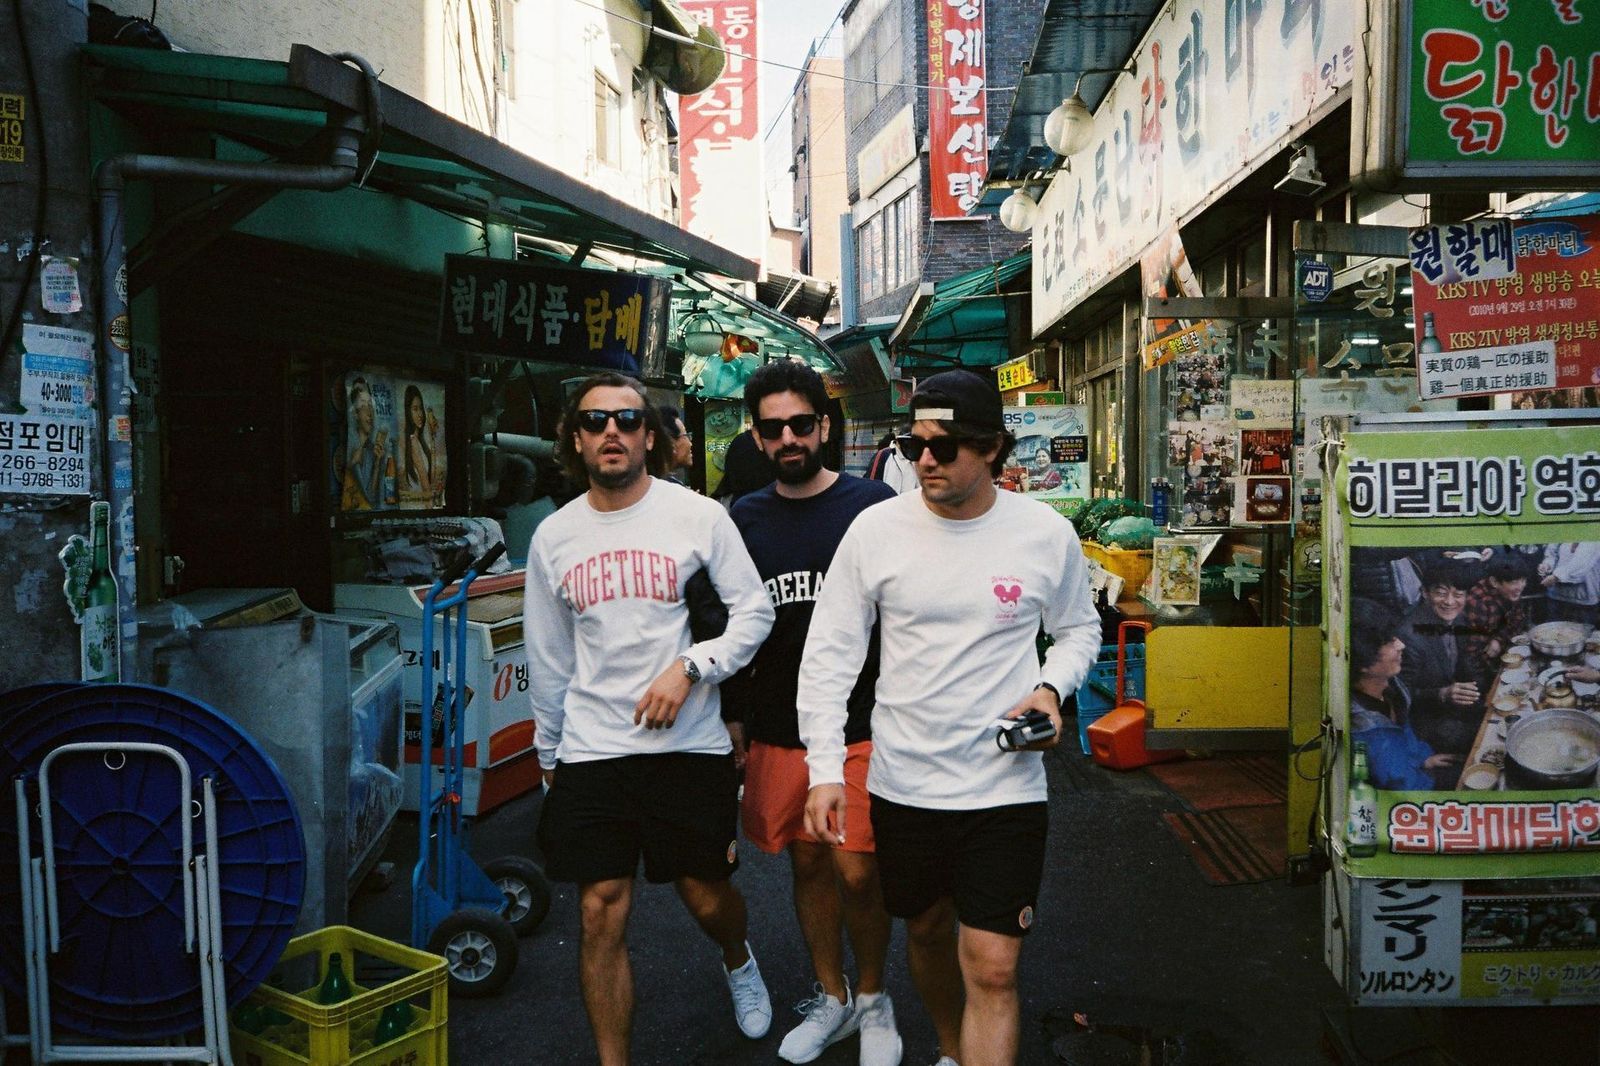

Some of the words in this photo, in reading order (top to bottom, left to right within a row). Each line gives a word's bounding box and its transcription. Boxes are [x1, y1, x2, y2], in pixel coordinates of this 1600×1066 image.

[1411, 218, 1515, 281] 원할매
[1303, 270, 1329, 288] ADT
[1529, 271, 1574, 294] 생방송
[1449, 331, 1476, 350] KBS
[1505, 326, 1531, 345] 방영
[1425, 349, 1549, 374] 実質の鶏一匹の援助
[1003, 412, 1023, 430] BS
[0, 421, 84, 454] 점포임대
[1348, 458, 1526, 517] 히말라야
[561, 549, 679, 615] TOGETHER
[1361, 967, 1454, 994] ソルロンタン
